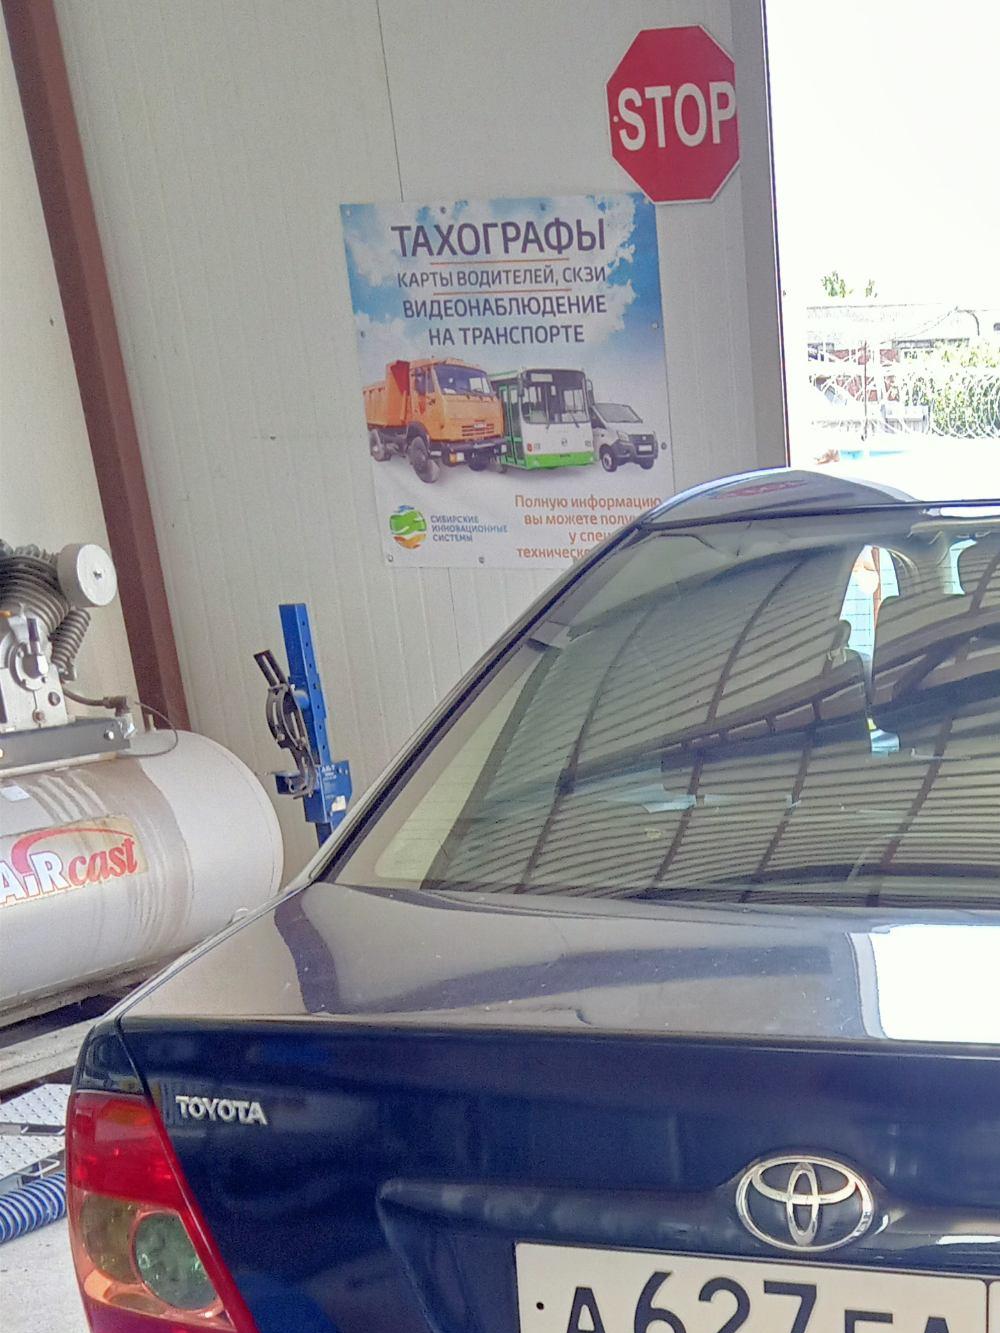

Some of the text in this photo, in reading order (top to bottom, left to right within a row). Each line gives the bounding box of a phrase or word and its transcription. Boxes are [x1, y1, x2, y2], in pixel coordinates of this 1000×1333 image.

[617, 80, 737, 151] STOP
[390, 217, 606, 258] ТАХОГРАФЫ
[397, 265, 607, 288] КАРТЫ ВОДИТЕЛЕЙ, СКЗИ
[402, 294, 608, 320] ВИДЕОНАБЛЮДЕНИЕ
[428, 324, 585, 346] НА ТРАНСПОРТЕ
[514, 494, 569, 511] Полную
[430, 515, 480, 524] СИБИРСКИЕ
[524, 514, 543, 525] вы
[545, 514, 599, 525] можете
[432, 534, 473, 542] СИСТЕМЫ
[175, 1095, 268, 1126] TOYOTA
